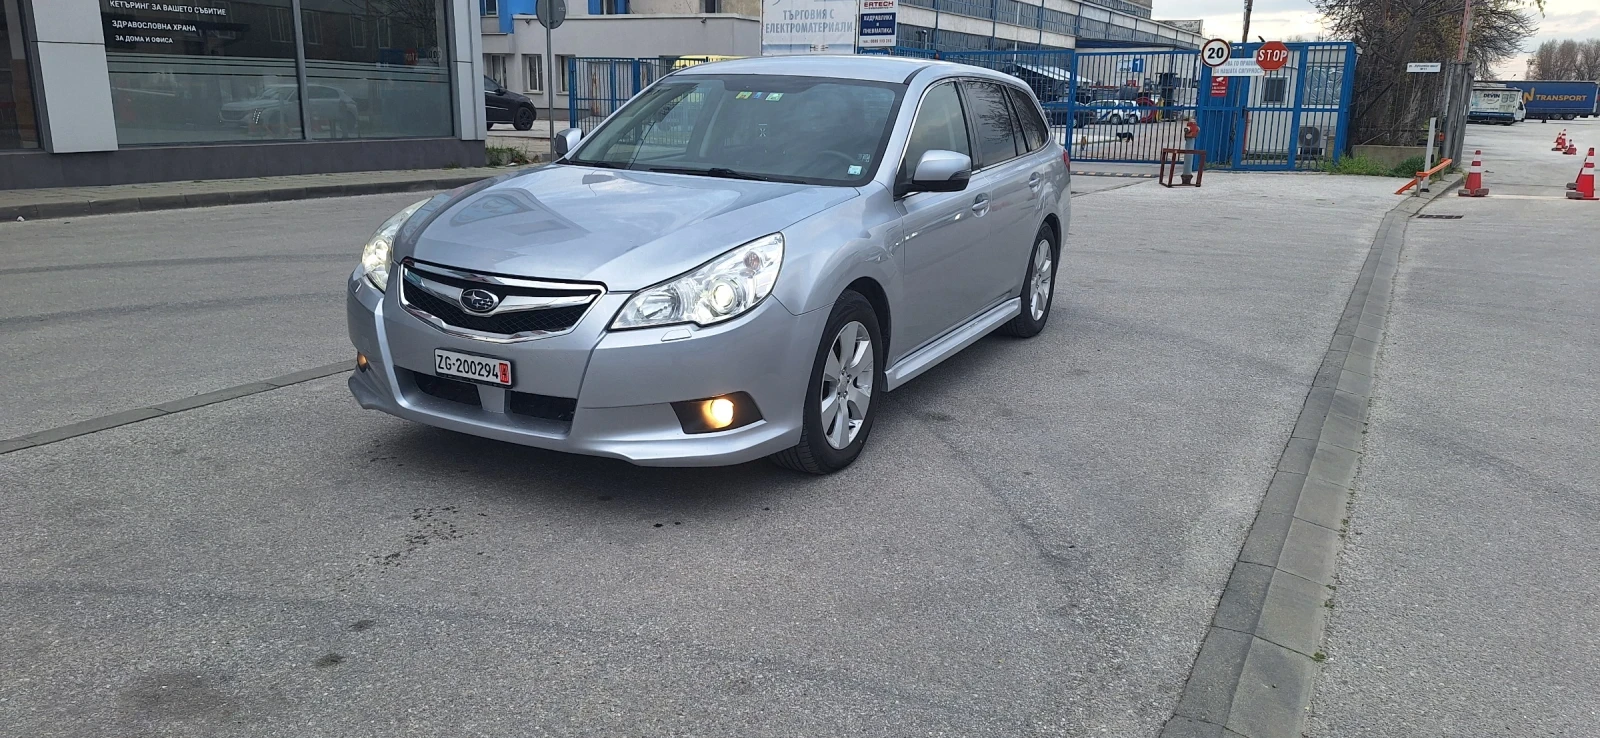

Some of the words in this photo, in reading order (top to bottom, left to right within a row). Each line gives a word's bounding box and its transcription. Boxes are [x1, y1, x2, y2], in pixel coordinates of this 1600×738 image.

[110, 0, 149, 10] КЕТЪРИНГ
[152, 3, 161, 11] ЗА
[163, 4, 192, 13] ВАШЕТО
[194, 7, 226, 16] СЪБИТИЕ
[783, 9, 827, 20] ТЪРГОВИЯ
[863, 14, 893, 22] ХИДРАВЛИКА
[112, 20, 172, 30] ЗДРАВОСЛОВНА
[173, 24, 197, 32] ХРАНА
[765, 22, 853, 34] ЕЛЕКТРОМАТЕРИАЛИ
[1207, 47, 1224, 59] 20
[1258, 49, 1287, 61] STOP
[1135, 60, 1140, 71] 1
